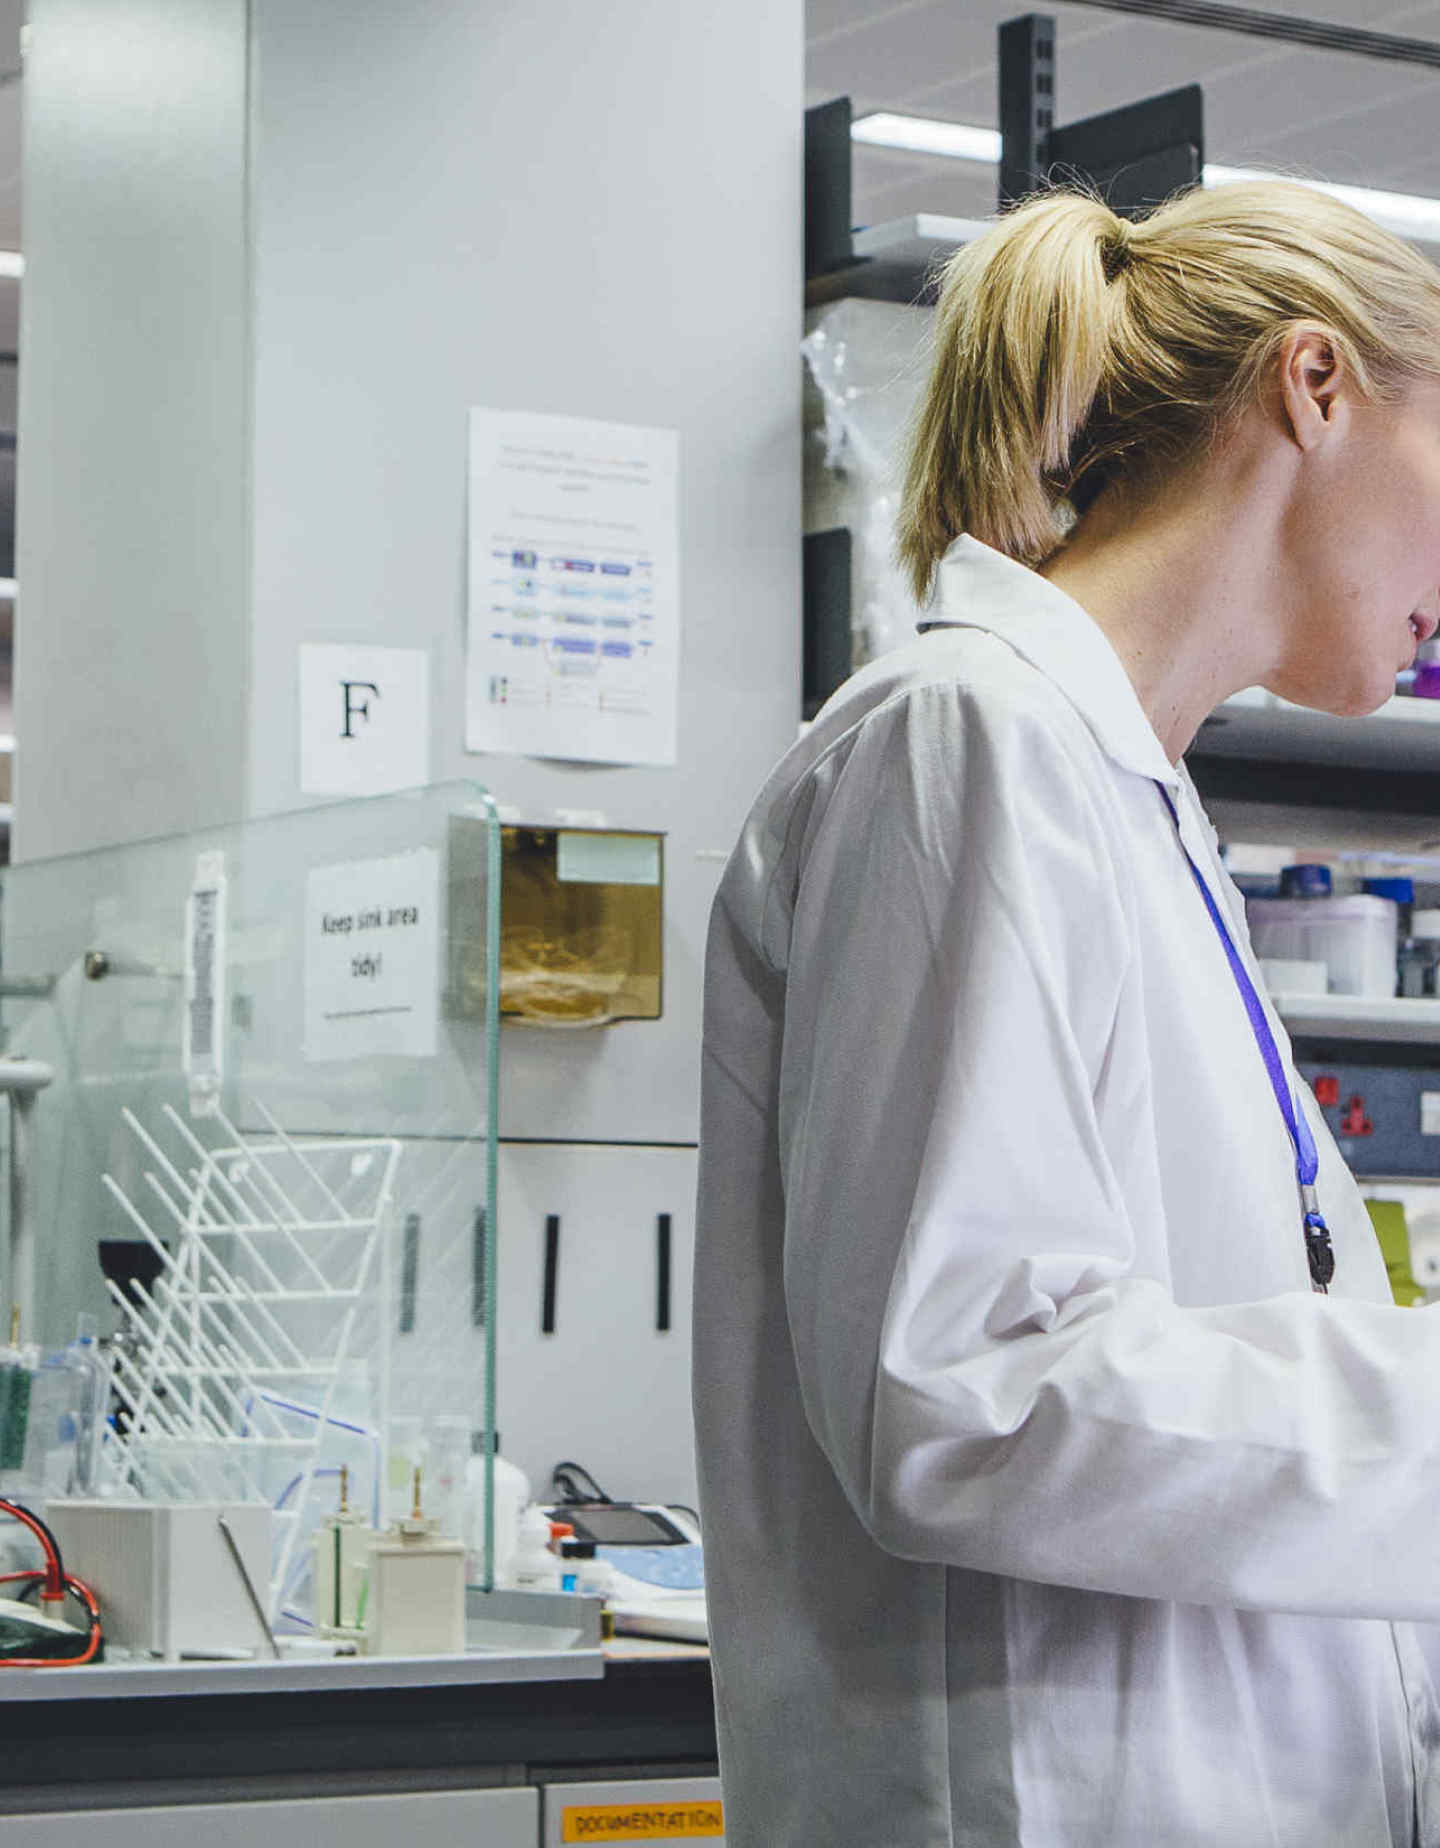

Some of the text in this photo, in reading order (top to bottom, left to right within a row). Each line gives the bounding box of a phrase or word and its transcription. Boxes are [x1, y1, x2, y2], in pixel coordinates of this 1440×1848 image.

[339, 682, 380, 737] F
[322, 905, 418, 936] Keep sink area
[351, 953, 382, 981] tidy!
[576, 1809, 720, 1834] DOCUMENTATION
